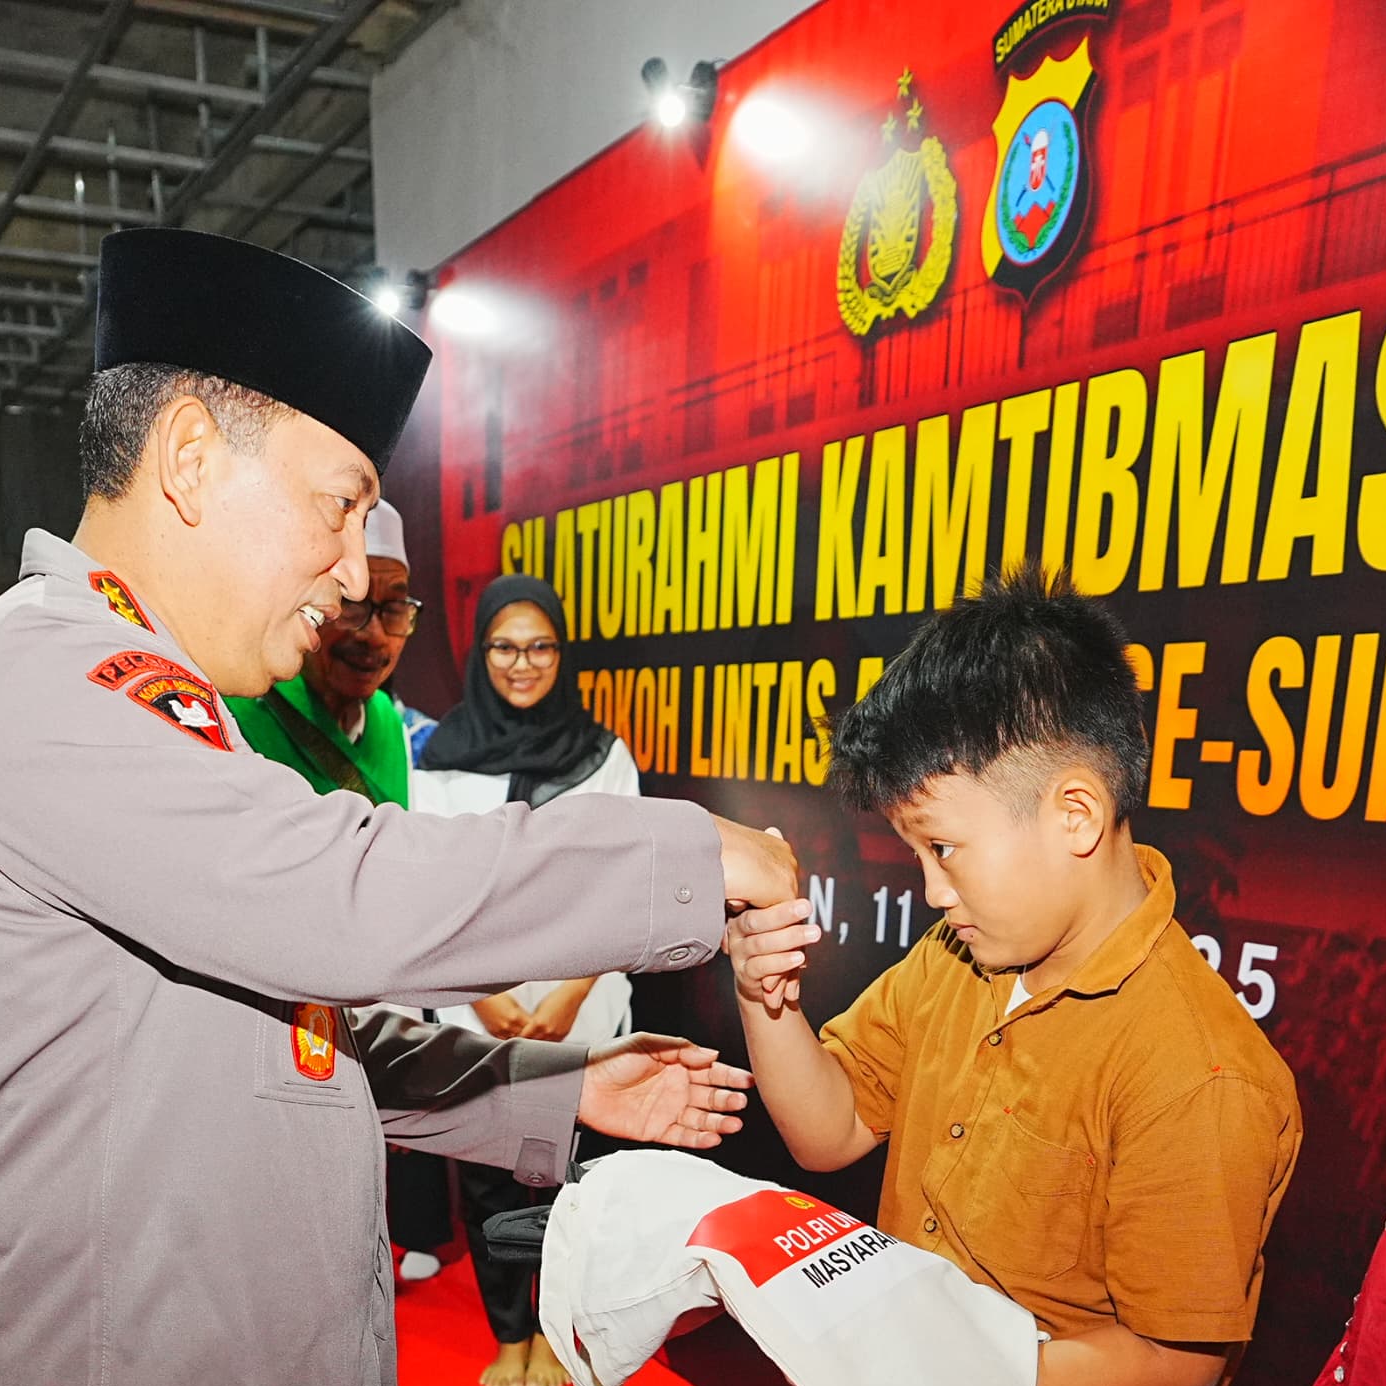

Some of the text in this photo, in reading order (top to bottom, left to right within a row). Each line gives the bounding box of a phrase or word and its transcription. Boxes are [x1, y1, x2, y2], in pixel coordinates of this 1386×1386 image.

[996, 0, 1064, 63] SUMATERA
[691, 659, 836, 786] LINTAS
[873, 885, 912, 948] 11
[773, 1217, 838, 1257] POLRI
[801, 1230, 899, 1288] MASYARA
